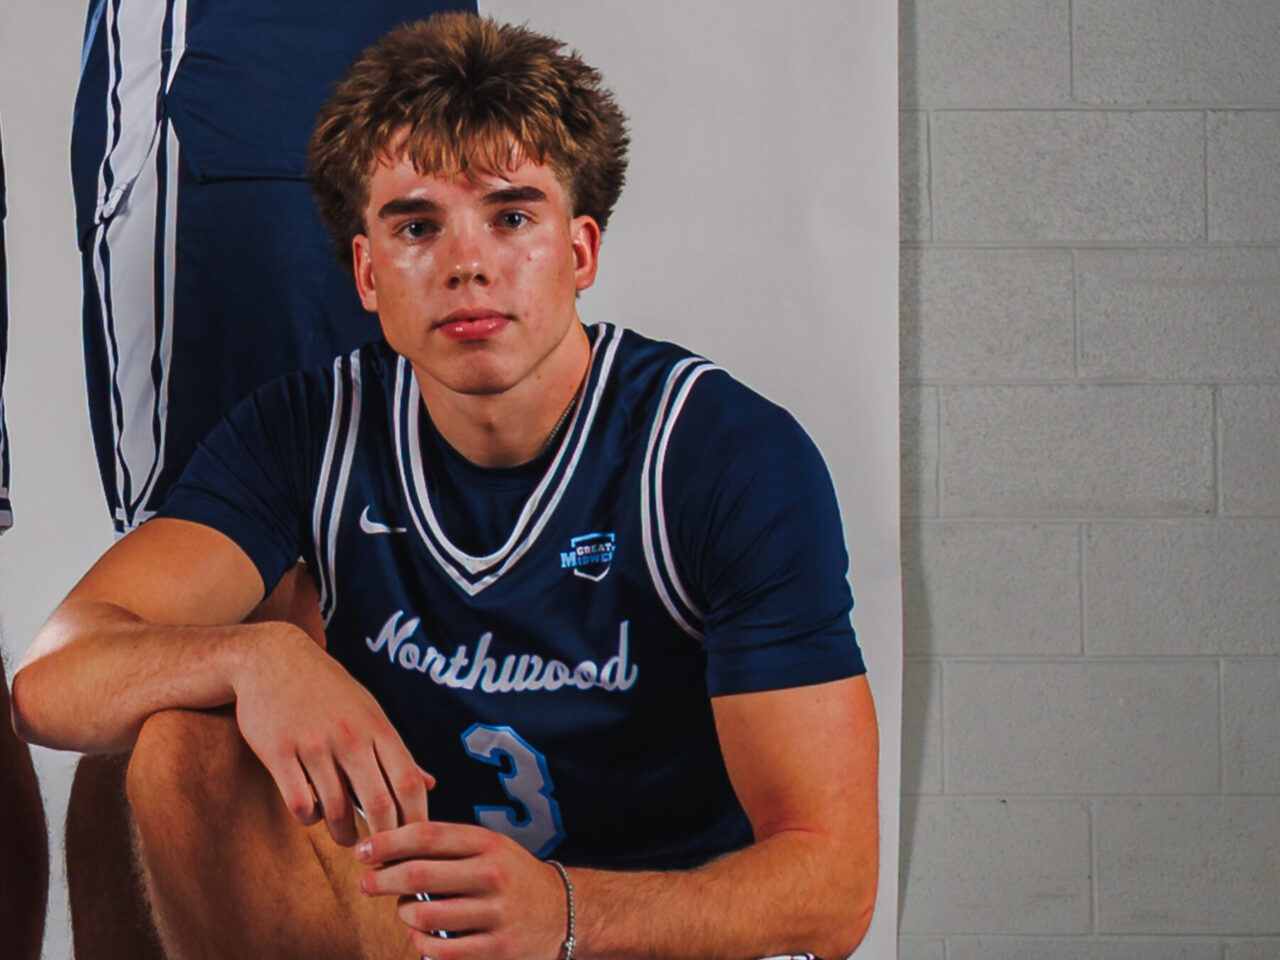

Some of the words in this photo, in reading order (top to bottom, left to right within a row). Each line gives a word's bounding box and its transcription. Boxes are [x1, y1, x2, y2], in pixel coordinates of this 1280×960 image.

[559, 546, 616, 568] MIDWE
[575, 542, 612, 556] GREAT
[365, 609, 639, 693] Northwood
[460, 722, 567, 858] 3
